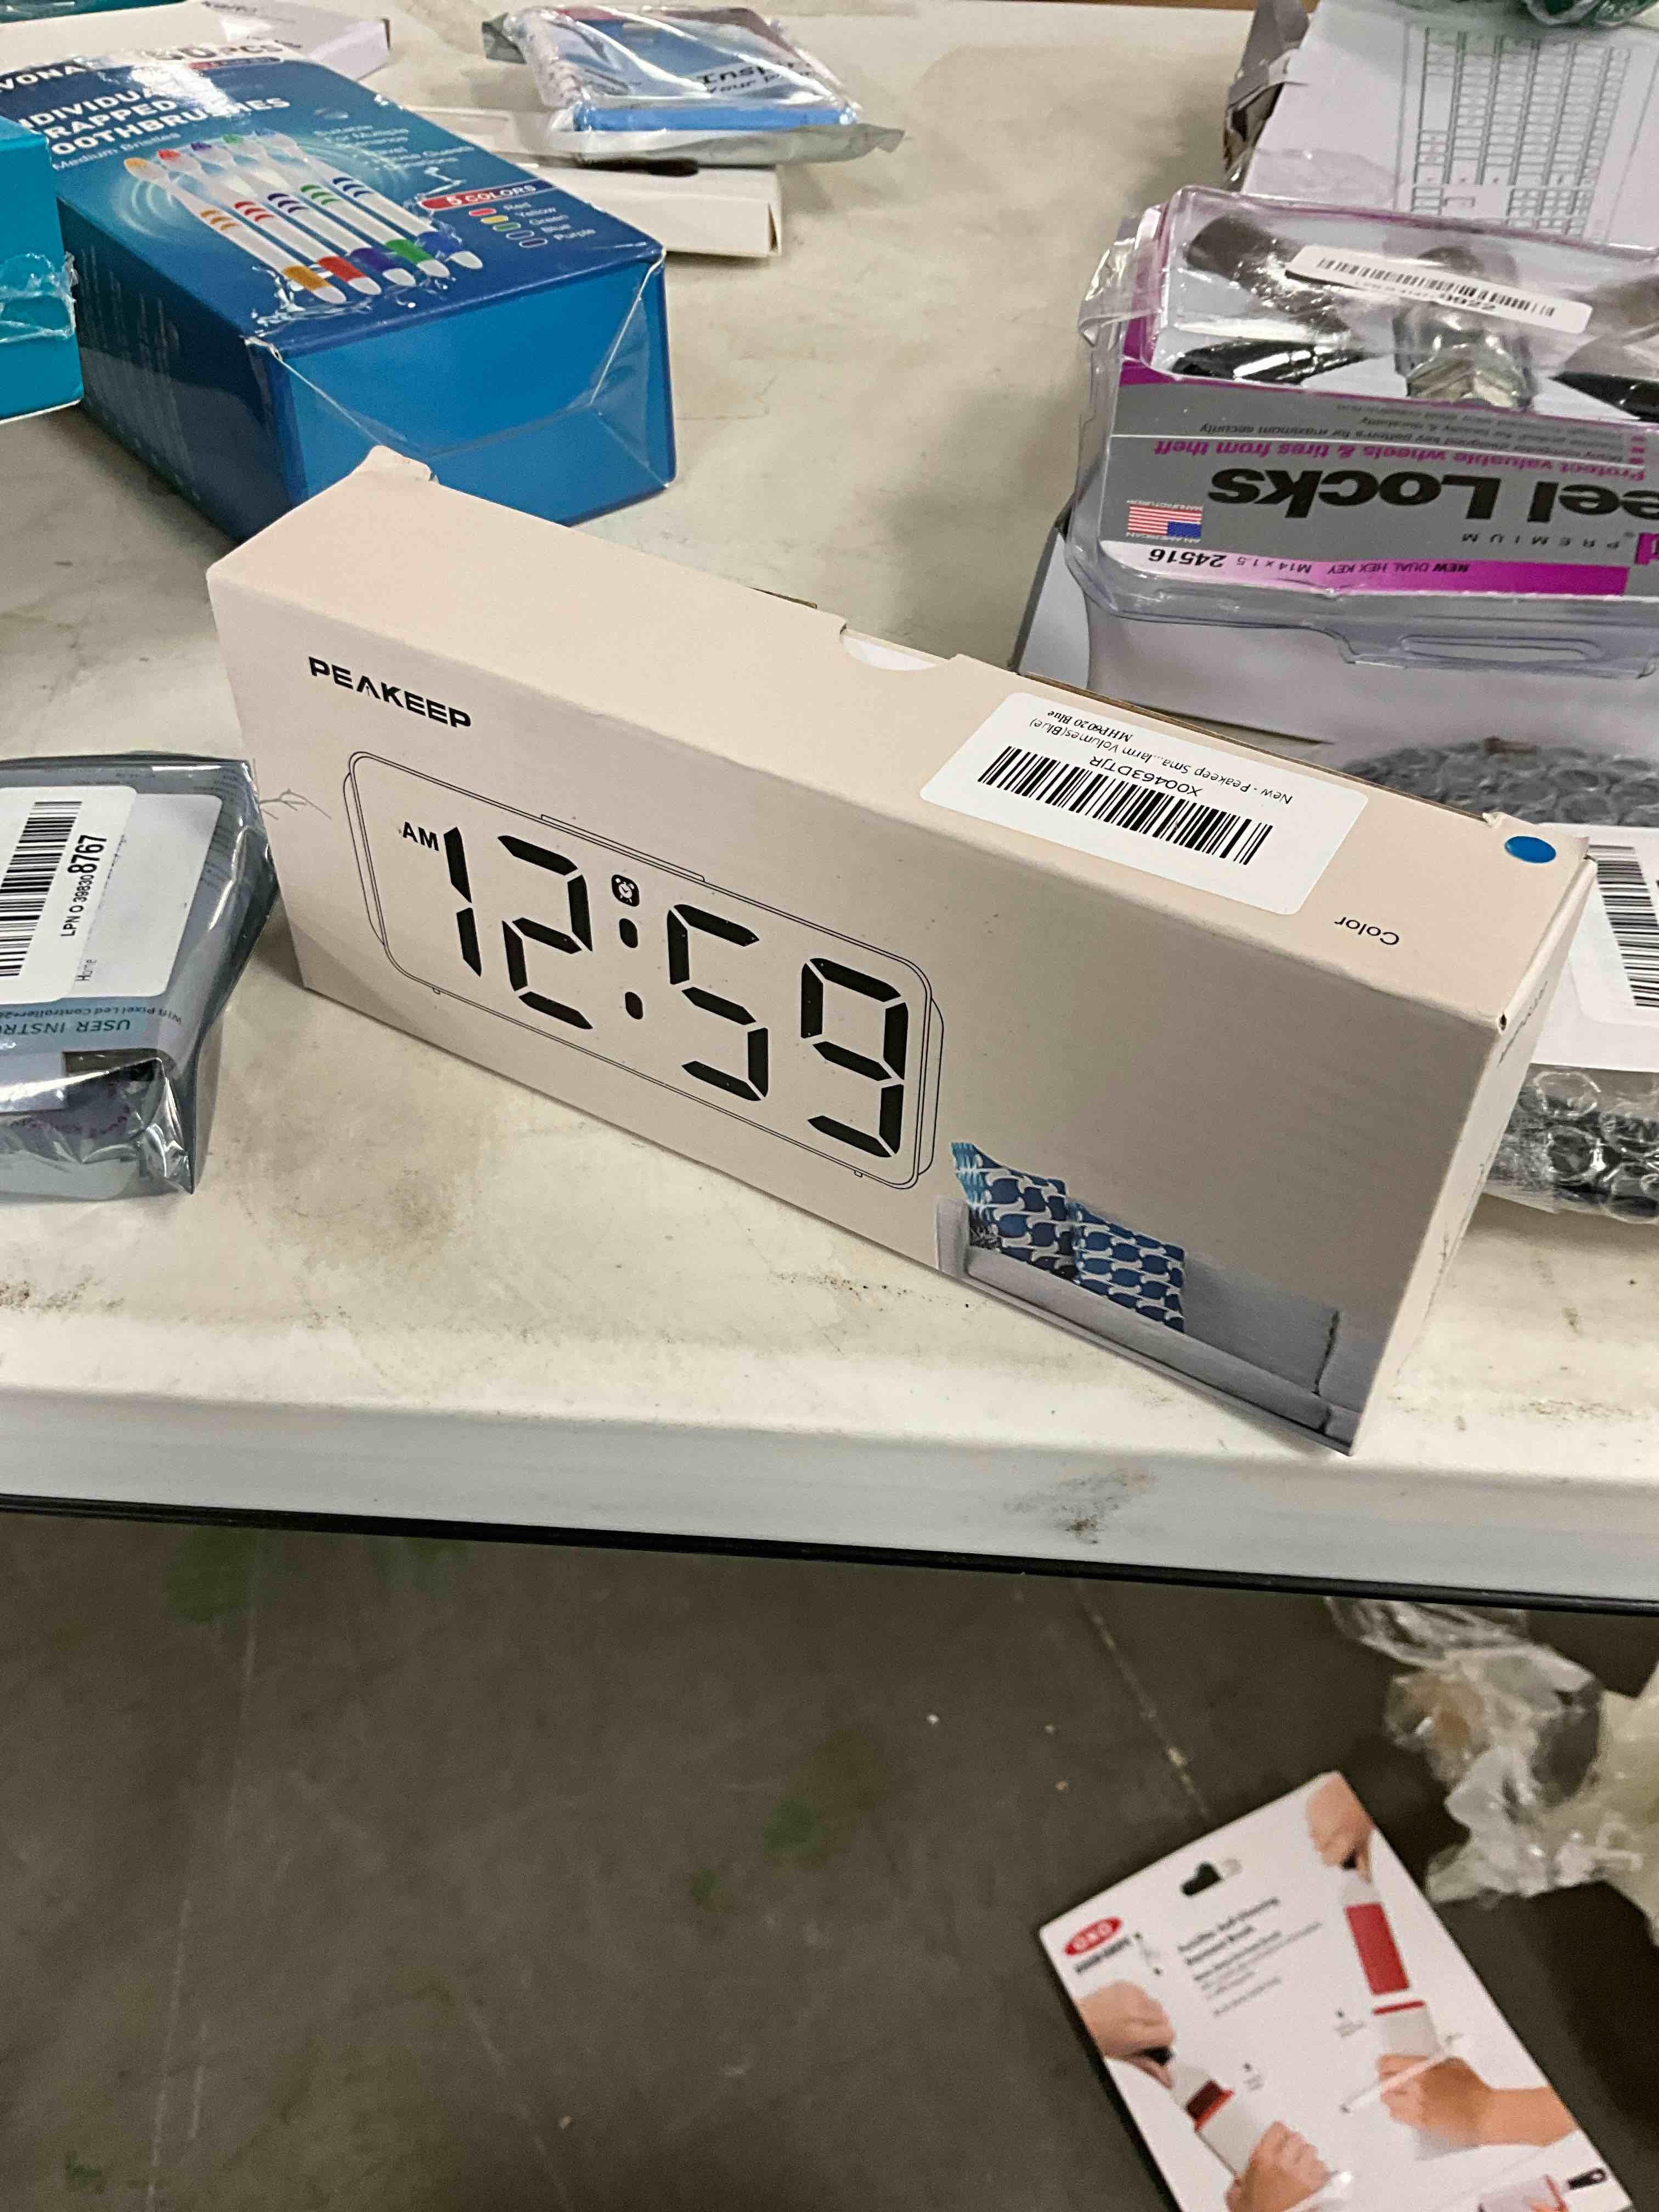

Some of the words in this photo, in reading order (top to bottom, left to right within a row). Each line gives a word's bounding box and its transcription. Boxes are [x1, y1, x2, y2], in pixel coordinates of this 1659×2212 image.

[44, 100, 178, 139] RAPPED
[52, 98, 291, 155] OOTHBRUES
[445, 195, 462, 206] 5
[465, 184, 537, 202] COLORS
[1154, 440, 1210, 456] theft
[1215, 441, 1272, 458] from
[1276, 442, 1330, 458] tires
[1336, 443, 1356, 458] &
[1362, 445, 1447, 462] wheels
[1559, 463, 1645, 481] Protect
[1206, 468, 1502, 520] Locks
[1462, 532, 1621, 549] PREMIUM
[1148, 548, 1227, 568] 24516
[1278, 562, 1313, 574] M14
[1327, 562, 1356, 574] KEY
[1357, 562, 1388, 573] HEX
[1392, 561, 1429, 573] DUAL
[1431, 562, 1471, 573] NEW
[308, 656, 471, 728] PEAKEEP
[1047, 710, 1073, 726] Blue
[1029, 717, 1119, 753] Volumes(Blue)
[1074, 718, 1134, 742] MHP6020
[1088, 755, 1203, 797] X00463DTJR
[1194, 767, 1251, 792] Peakeep
[1260, 789, 1293, 805] New
[402, 821, 439, 851] AM
[60, 916, 81, 936] LPN
[1334, 915, 1401, 947] Color
[95, 1007, 119, 1015] Led
[123, 1007, 155, 1015] Pixel
[0, 1021, 66, 1036] INSTR
[76, 1019, 131, 1034] USER
